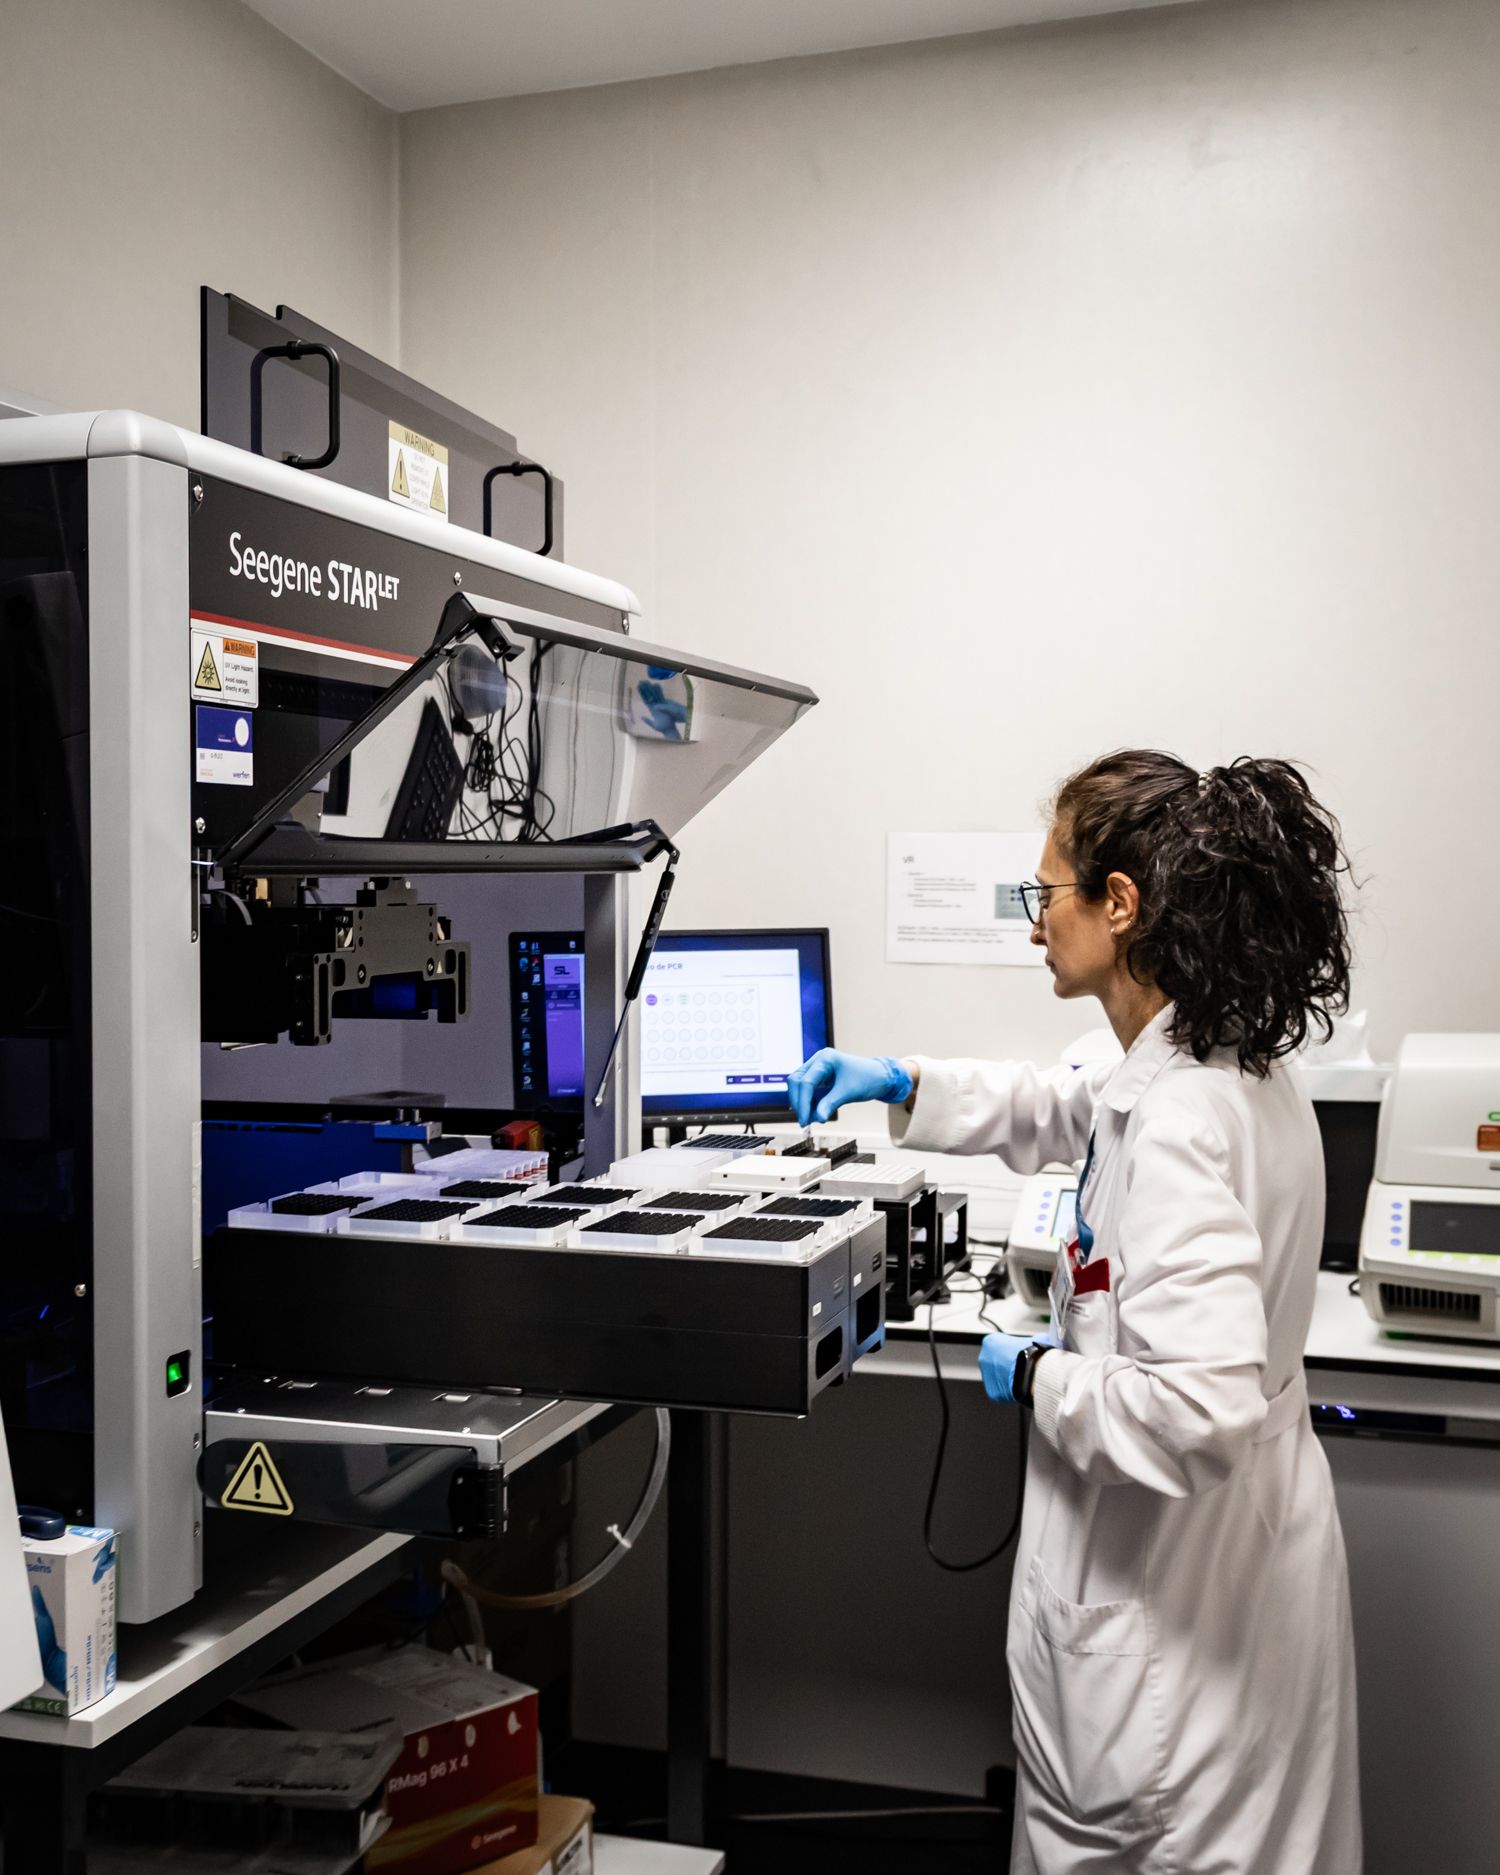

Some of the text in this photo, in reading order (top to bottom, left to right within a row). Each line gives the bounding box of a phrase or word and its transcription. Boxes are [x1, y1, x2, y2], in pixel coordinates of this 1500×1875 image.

[404, 430, 435, 457] WARNING
[229, 532, 322, 598] Seegene
[231, 641, 256, 656] WARNING
[553, 965, 571, 976] SL
[667, 962, 683, 970] PCR
[388, 1771, 428, 1793] RMag
[430, 1761, 447, 1780] 96
[460, 1753, 469, 1768] 4
